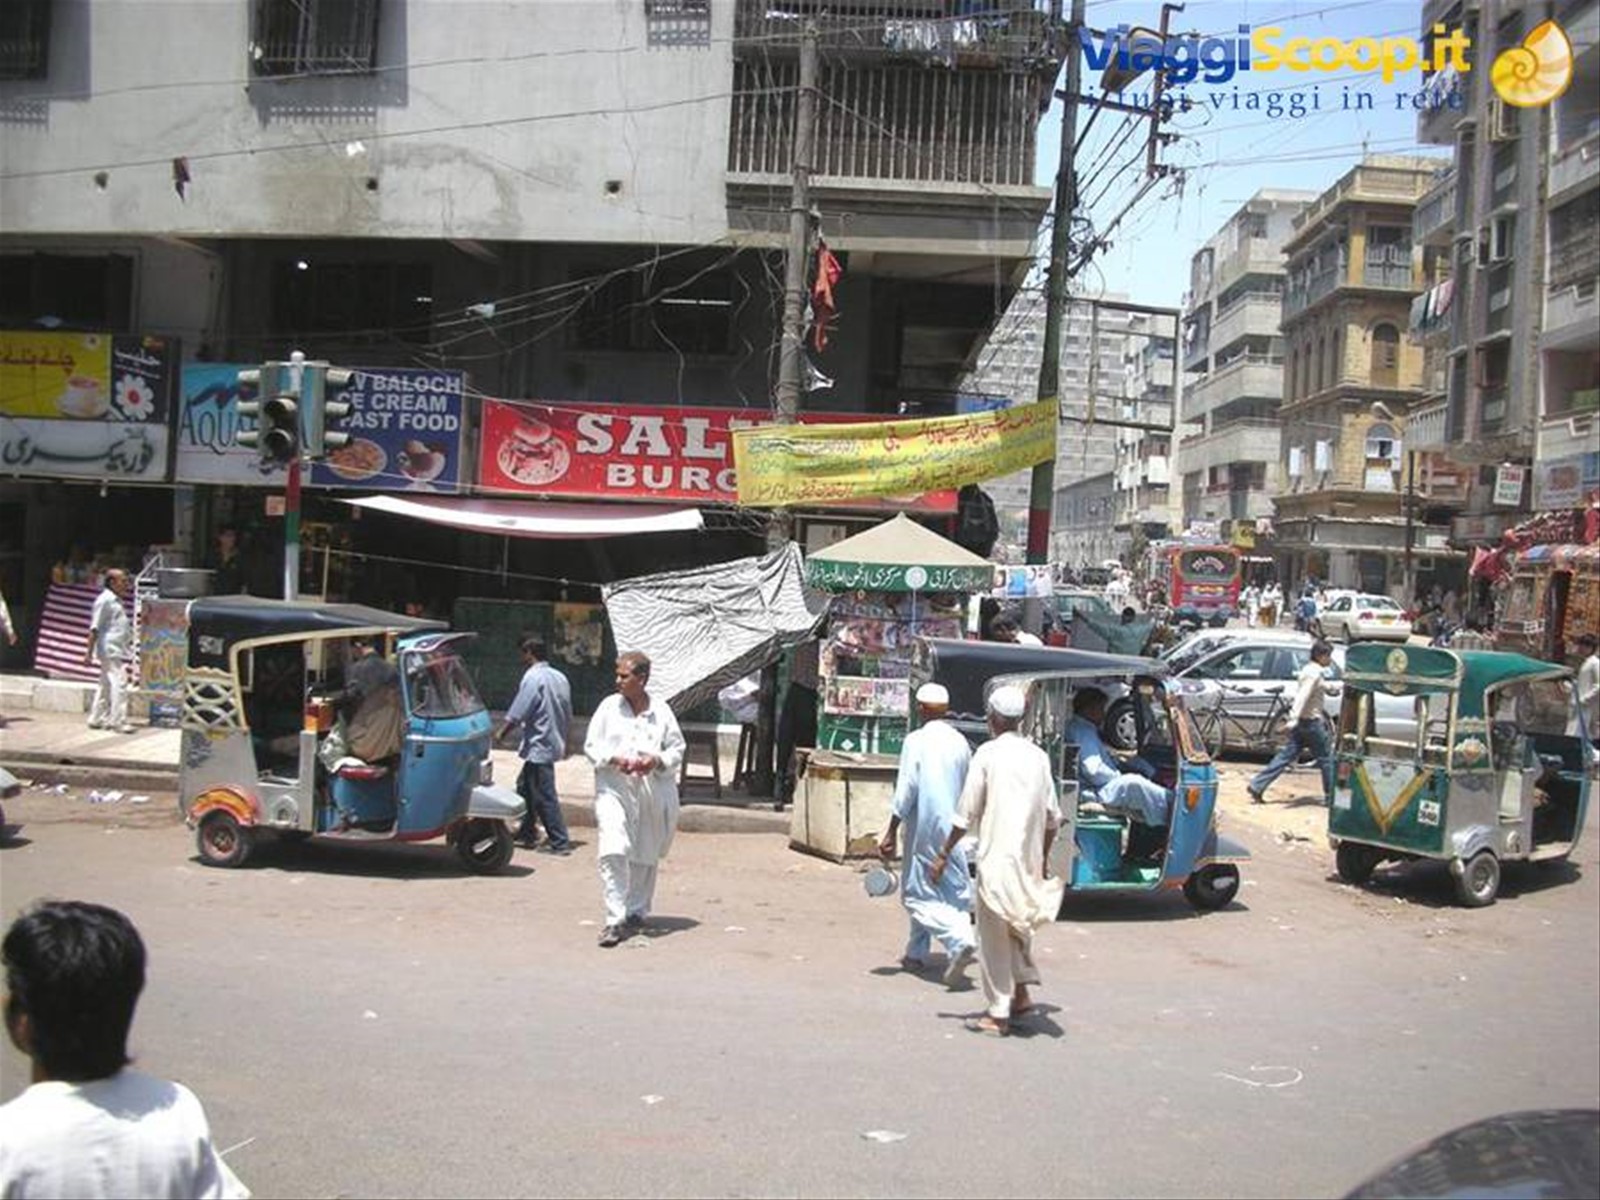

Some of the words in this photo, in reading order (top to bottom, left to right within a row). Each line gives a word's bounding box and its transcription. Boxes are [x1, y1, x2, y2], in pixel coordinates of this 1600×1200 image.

[372, 374, 461, 394] BALOCH
[371, 393, 448, 413] CREAM
[399, 414, 459, 431] FOOD
